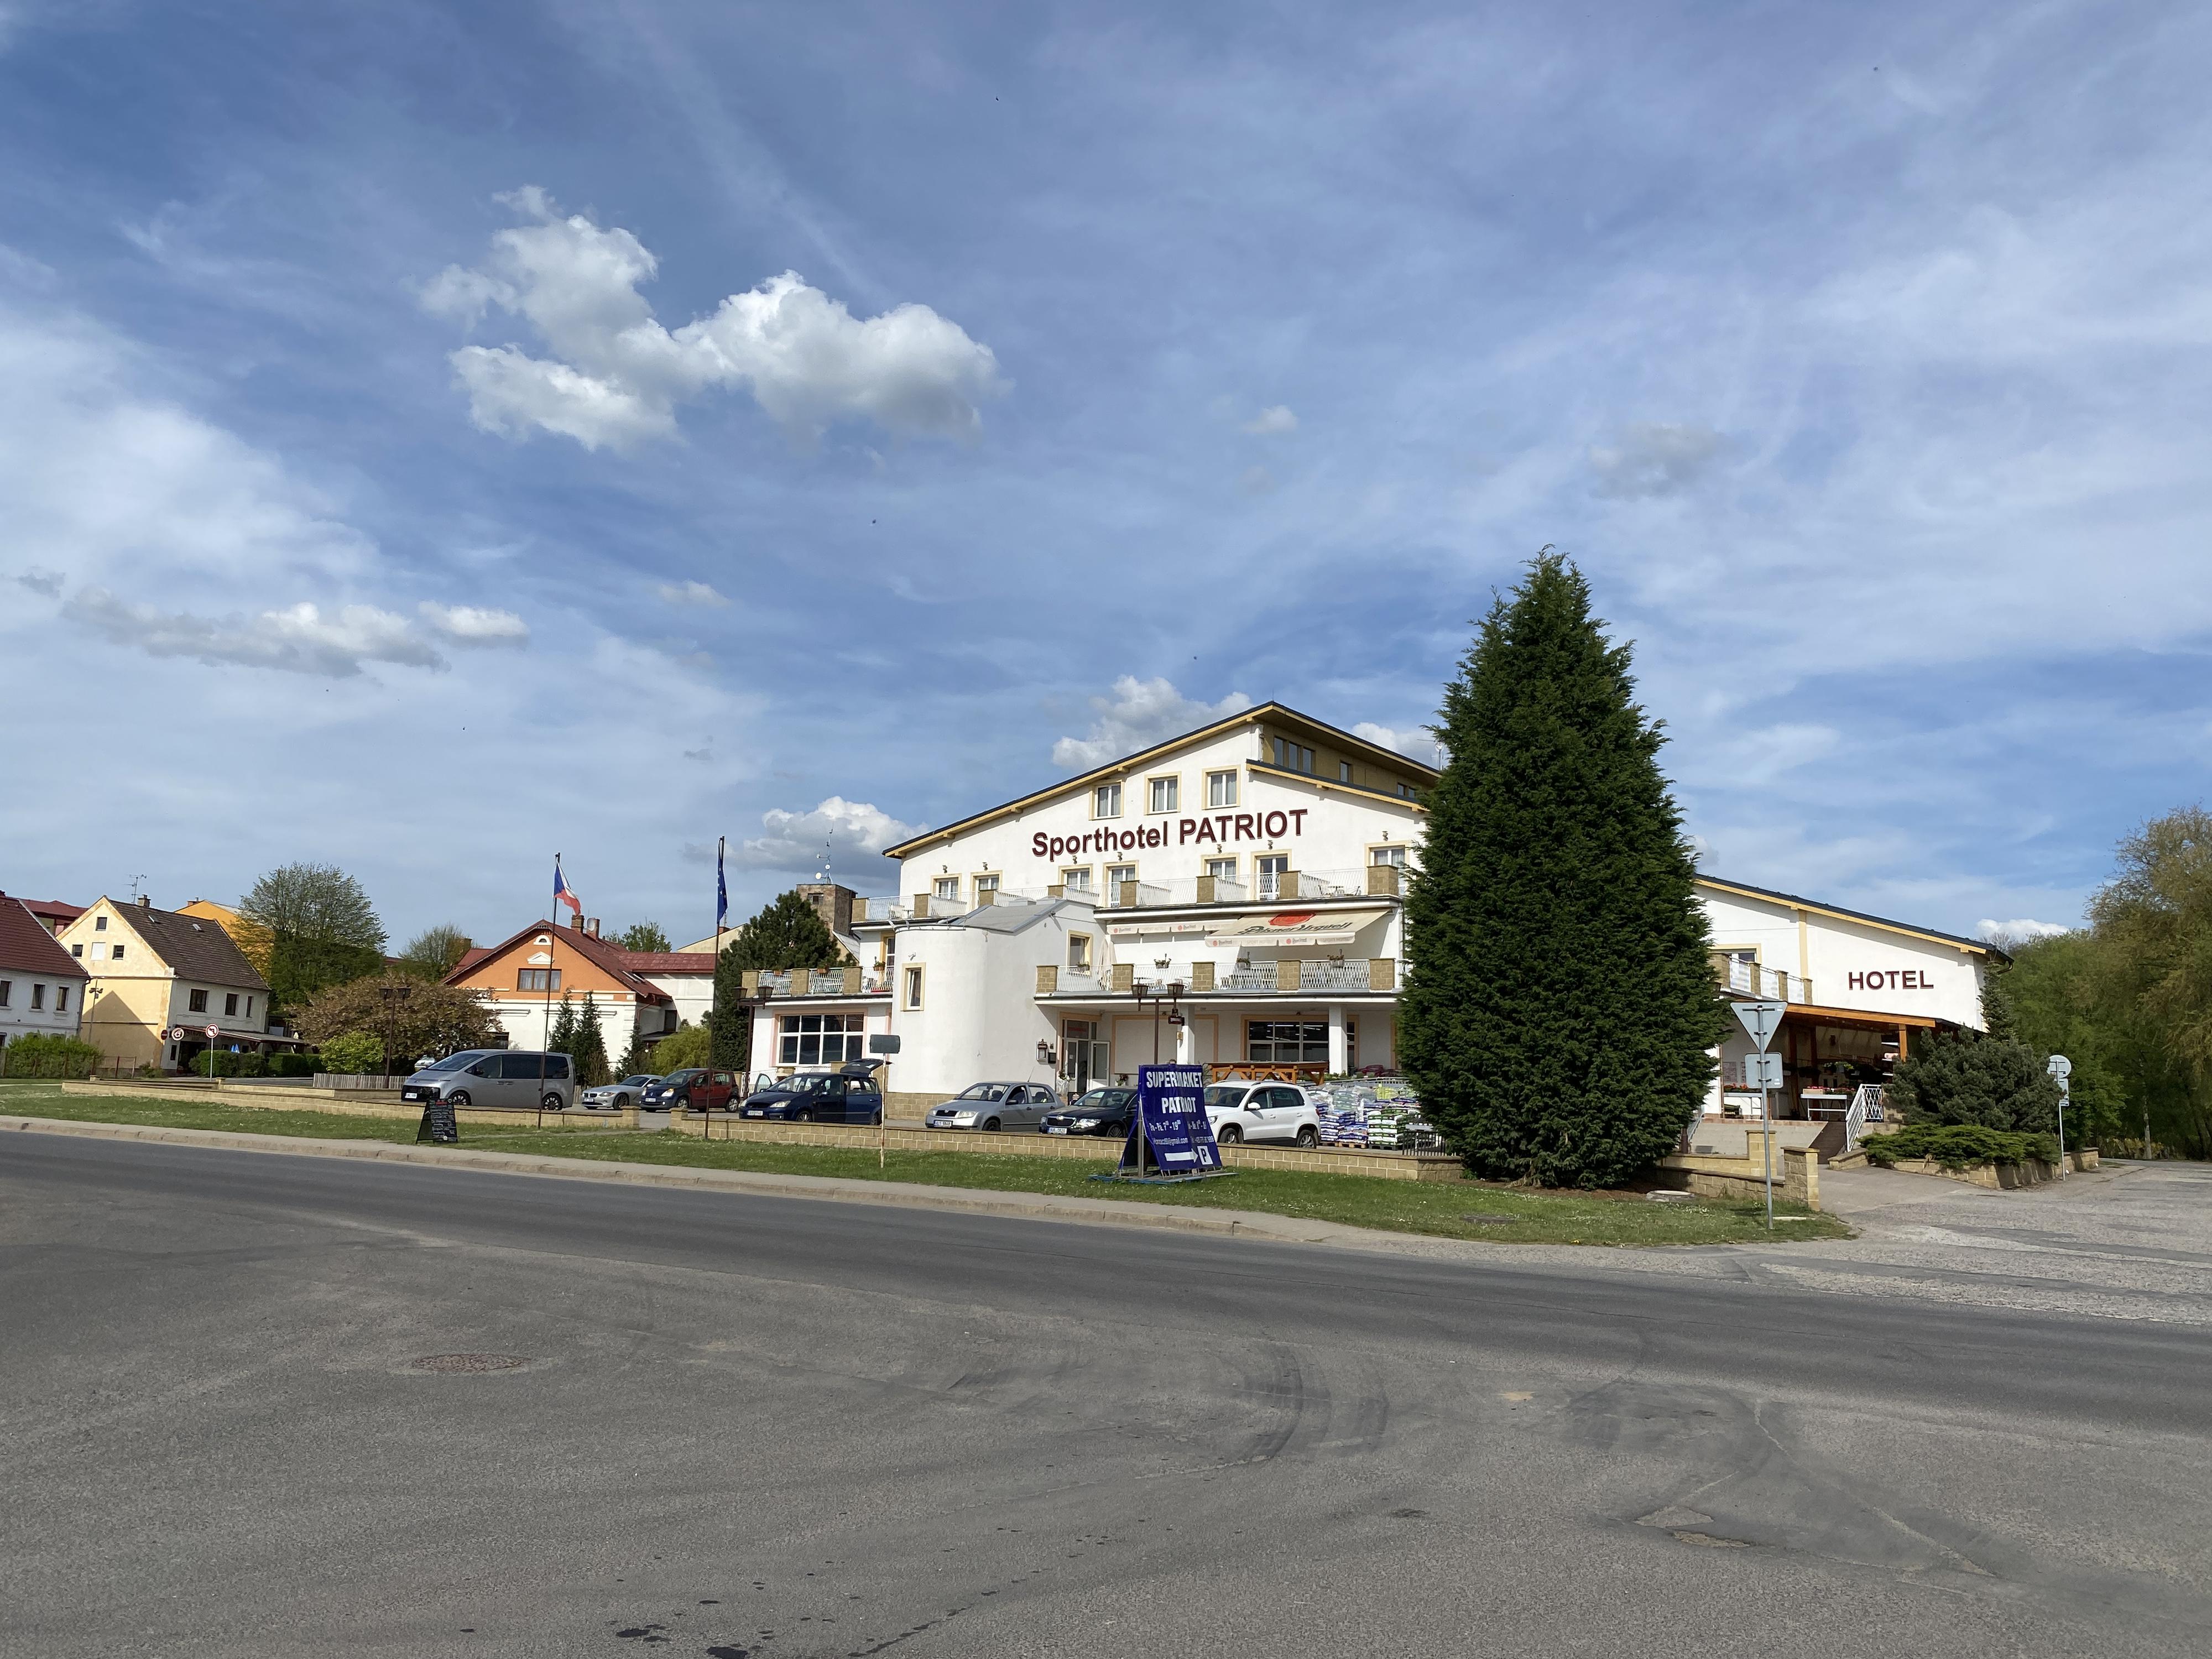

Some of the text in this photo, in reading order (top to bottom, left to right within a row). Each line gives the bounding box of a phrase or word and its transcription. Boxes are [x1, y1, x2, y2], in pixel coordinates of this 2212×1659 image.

[1032, 809, 1308, 862] Sporthotel PATRIOT
[1849, 970, 1934, 990] HOTEL
[1161, 1097, 1197, 1114] PATRIOT
[1200, 1148, 1207, 1164] P
